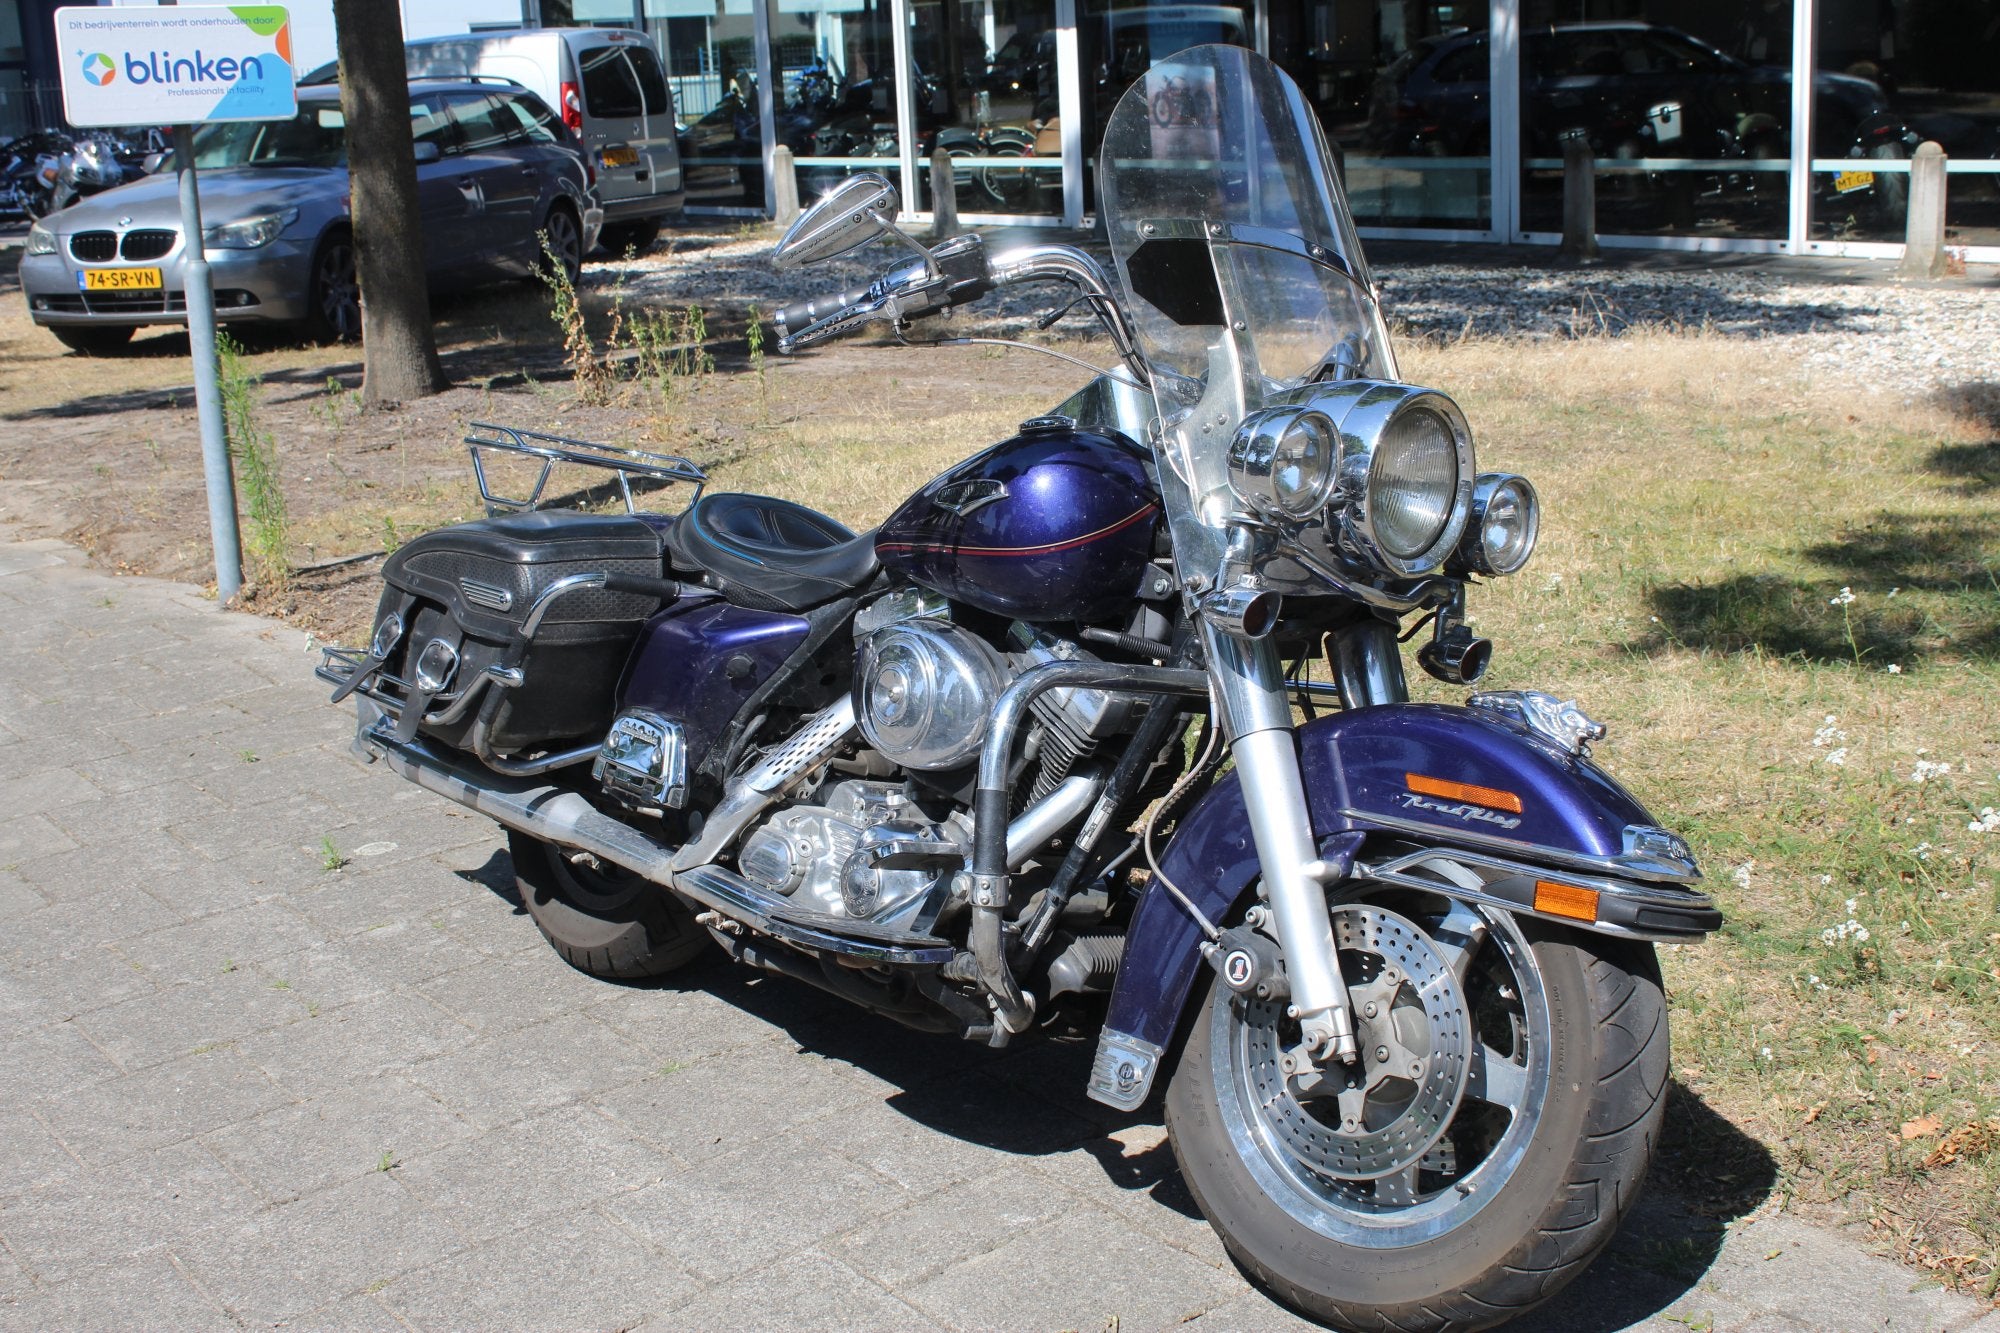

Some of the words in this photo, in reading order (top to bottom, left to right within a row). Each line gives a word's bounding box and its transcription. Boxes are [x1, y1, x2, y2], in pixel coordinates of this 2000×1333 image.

[69, 21, 82, 30] Dit
[84, 19, 159, 32] bedrijventerrein
[161, 18, 188, 27] wordt
[190, 16, 251, 26] onderhouden
[124, 49, 264, 85] blinken
[167, 87, 225, 97] Professionals
[226, 86, 235, 95] in
[237, 85, 265, 95] facility
[88, 271, 155, 287] 74-SR-VN
